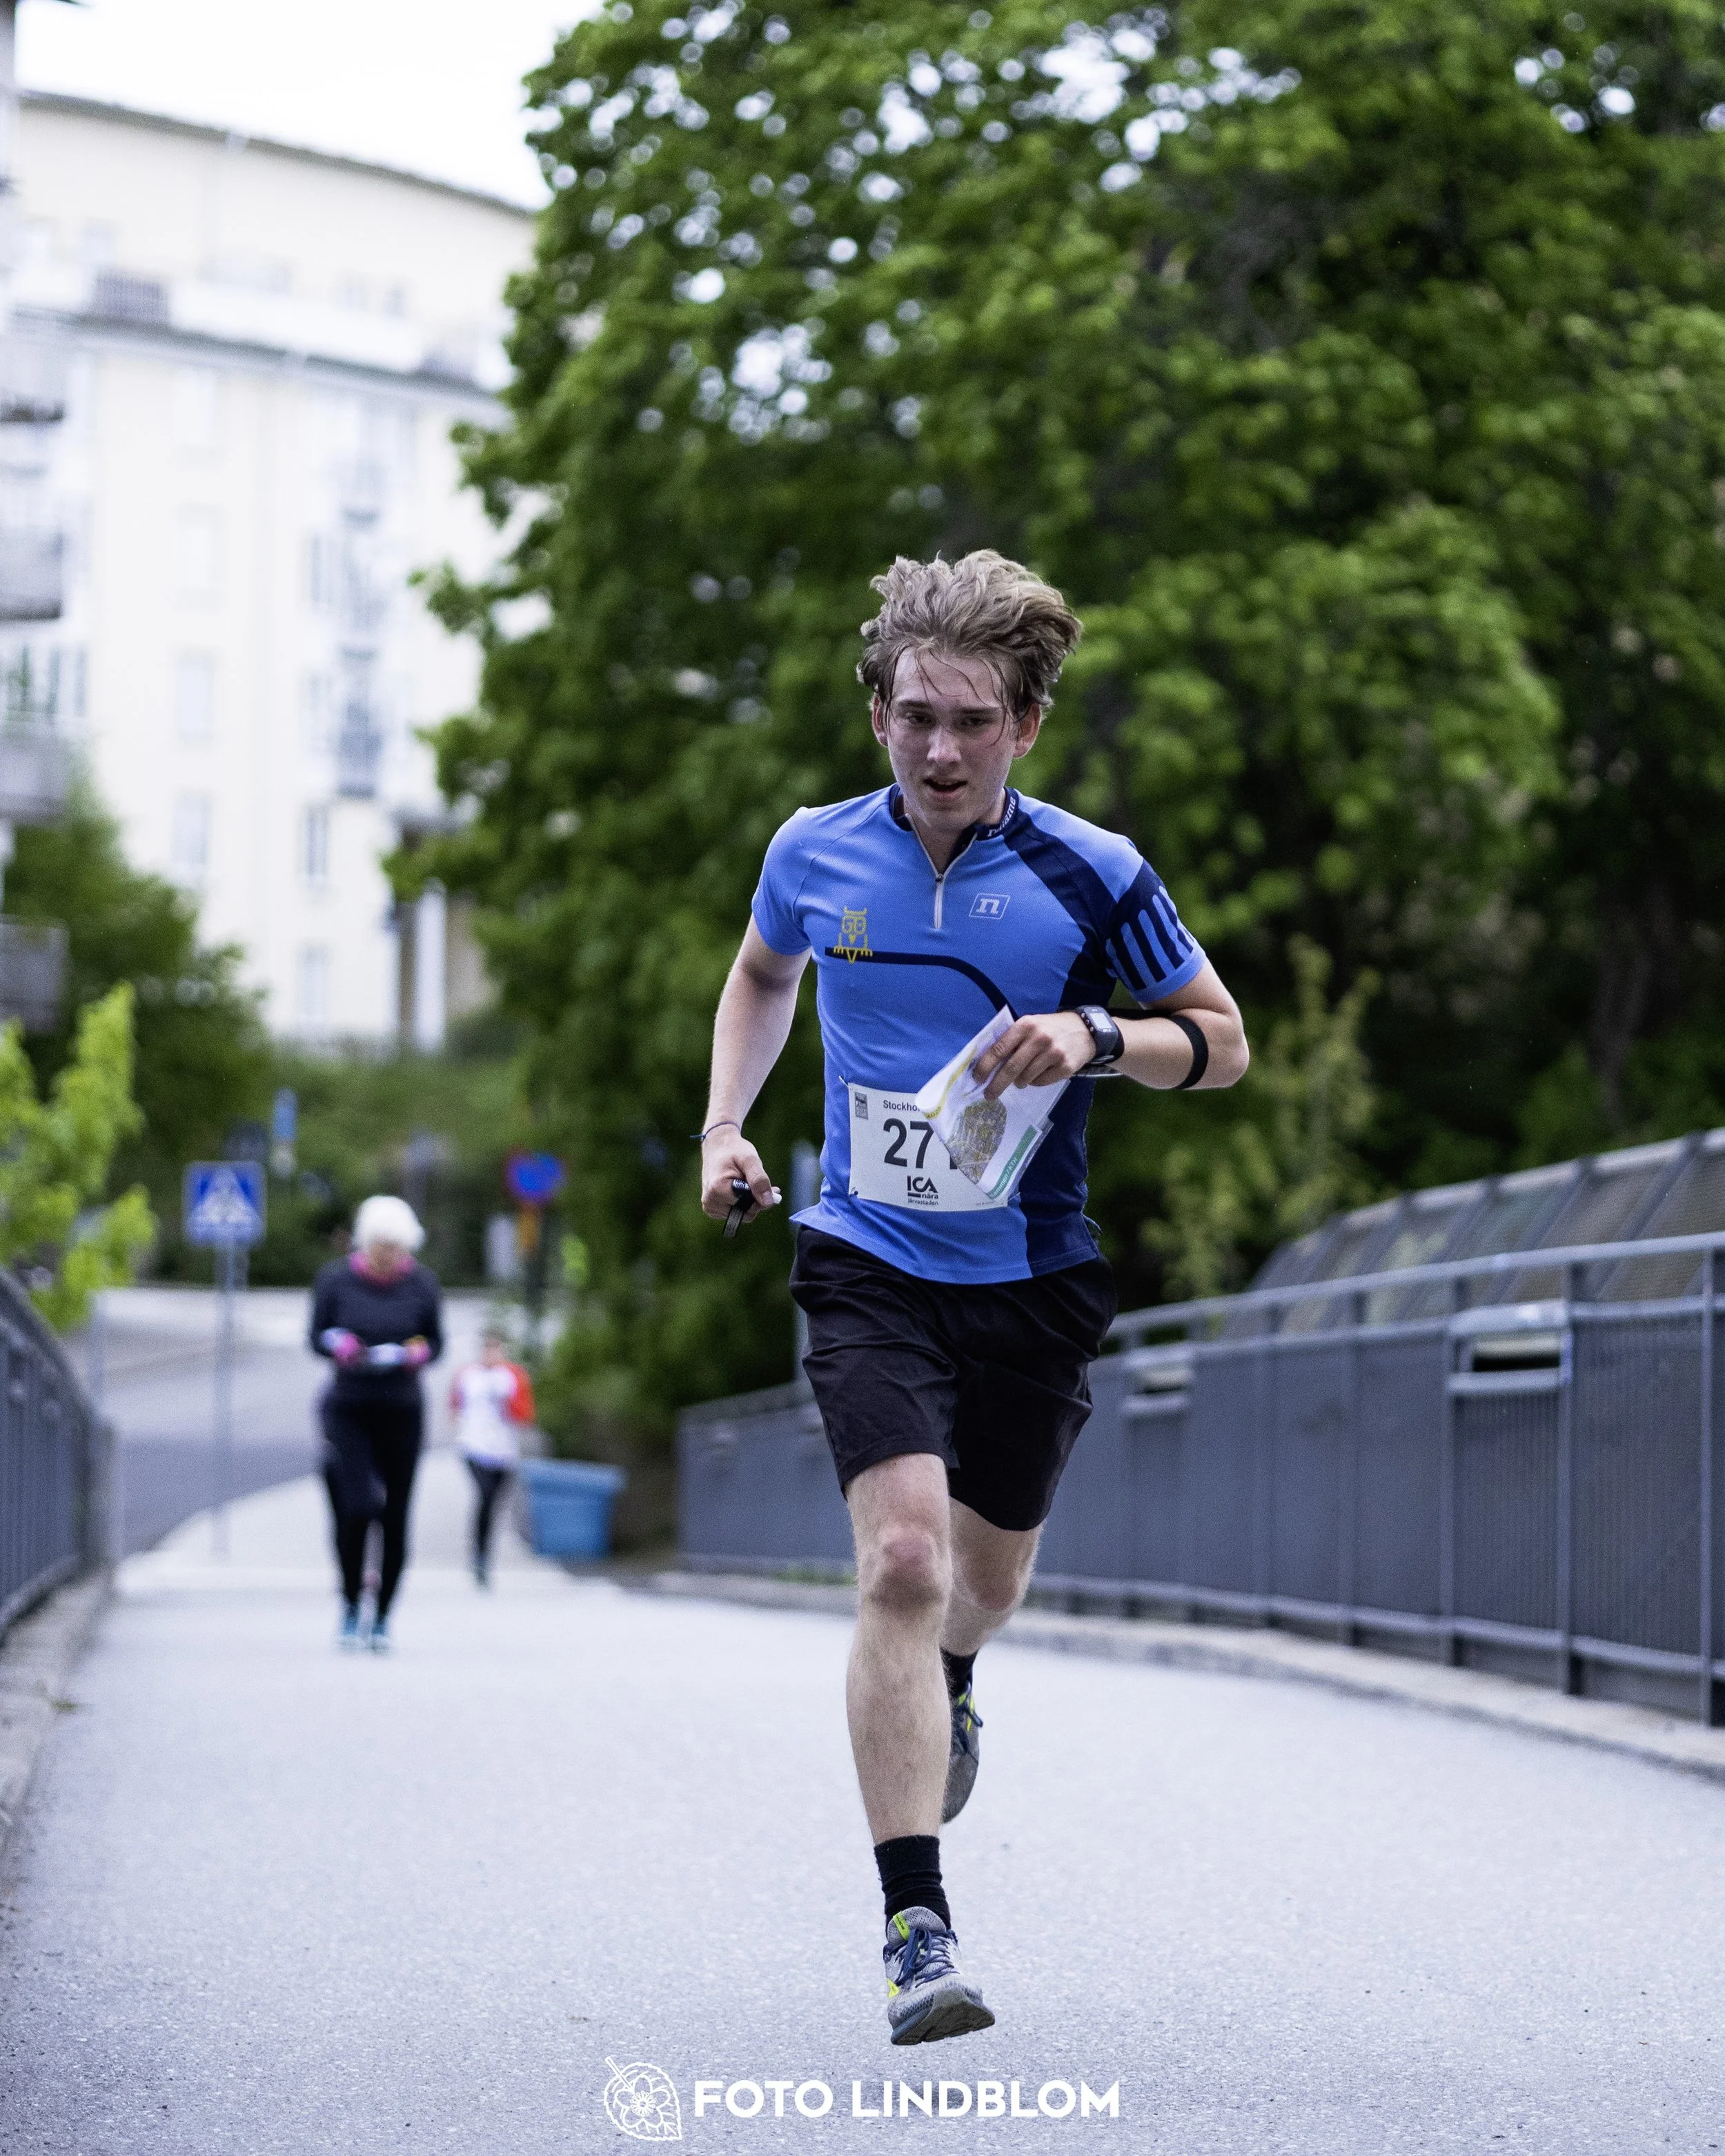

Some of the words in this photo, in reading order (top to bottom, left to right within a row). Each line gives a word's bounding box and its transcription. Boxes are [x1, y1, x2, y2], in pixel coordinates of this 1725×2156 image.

[883, 1100, 920, 1111] Stockho
[883, 1118, 958, 1169] 27
[907, 1176, 938, 1193] ICA
